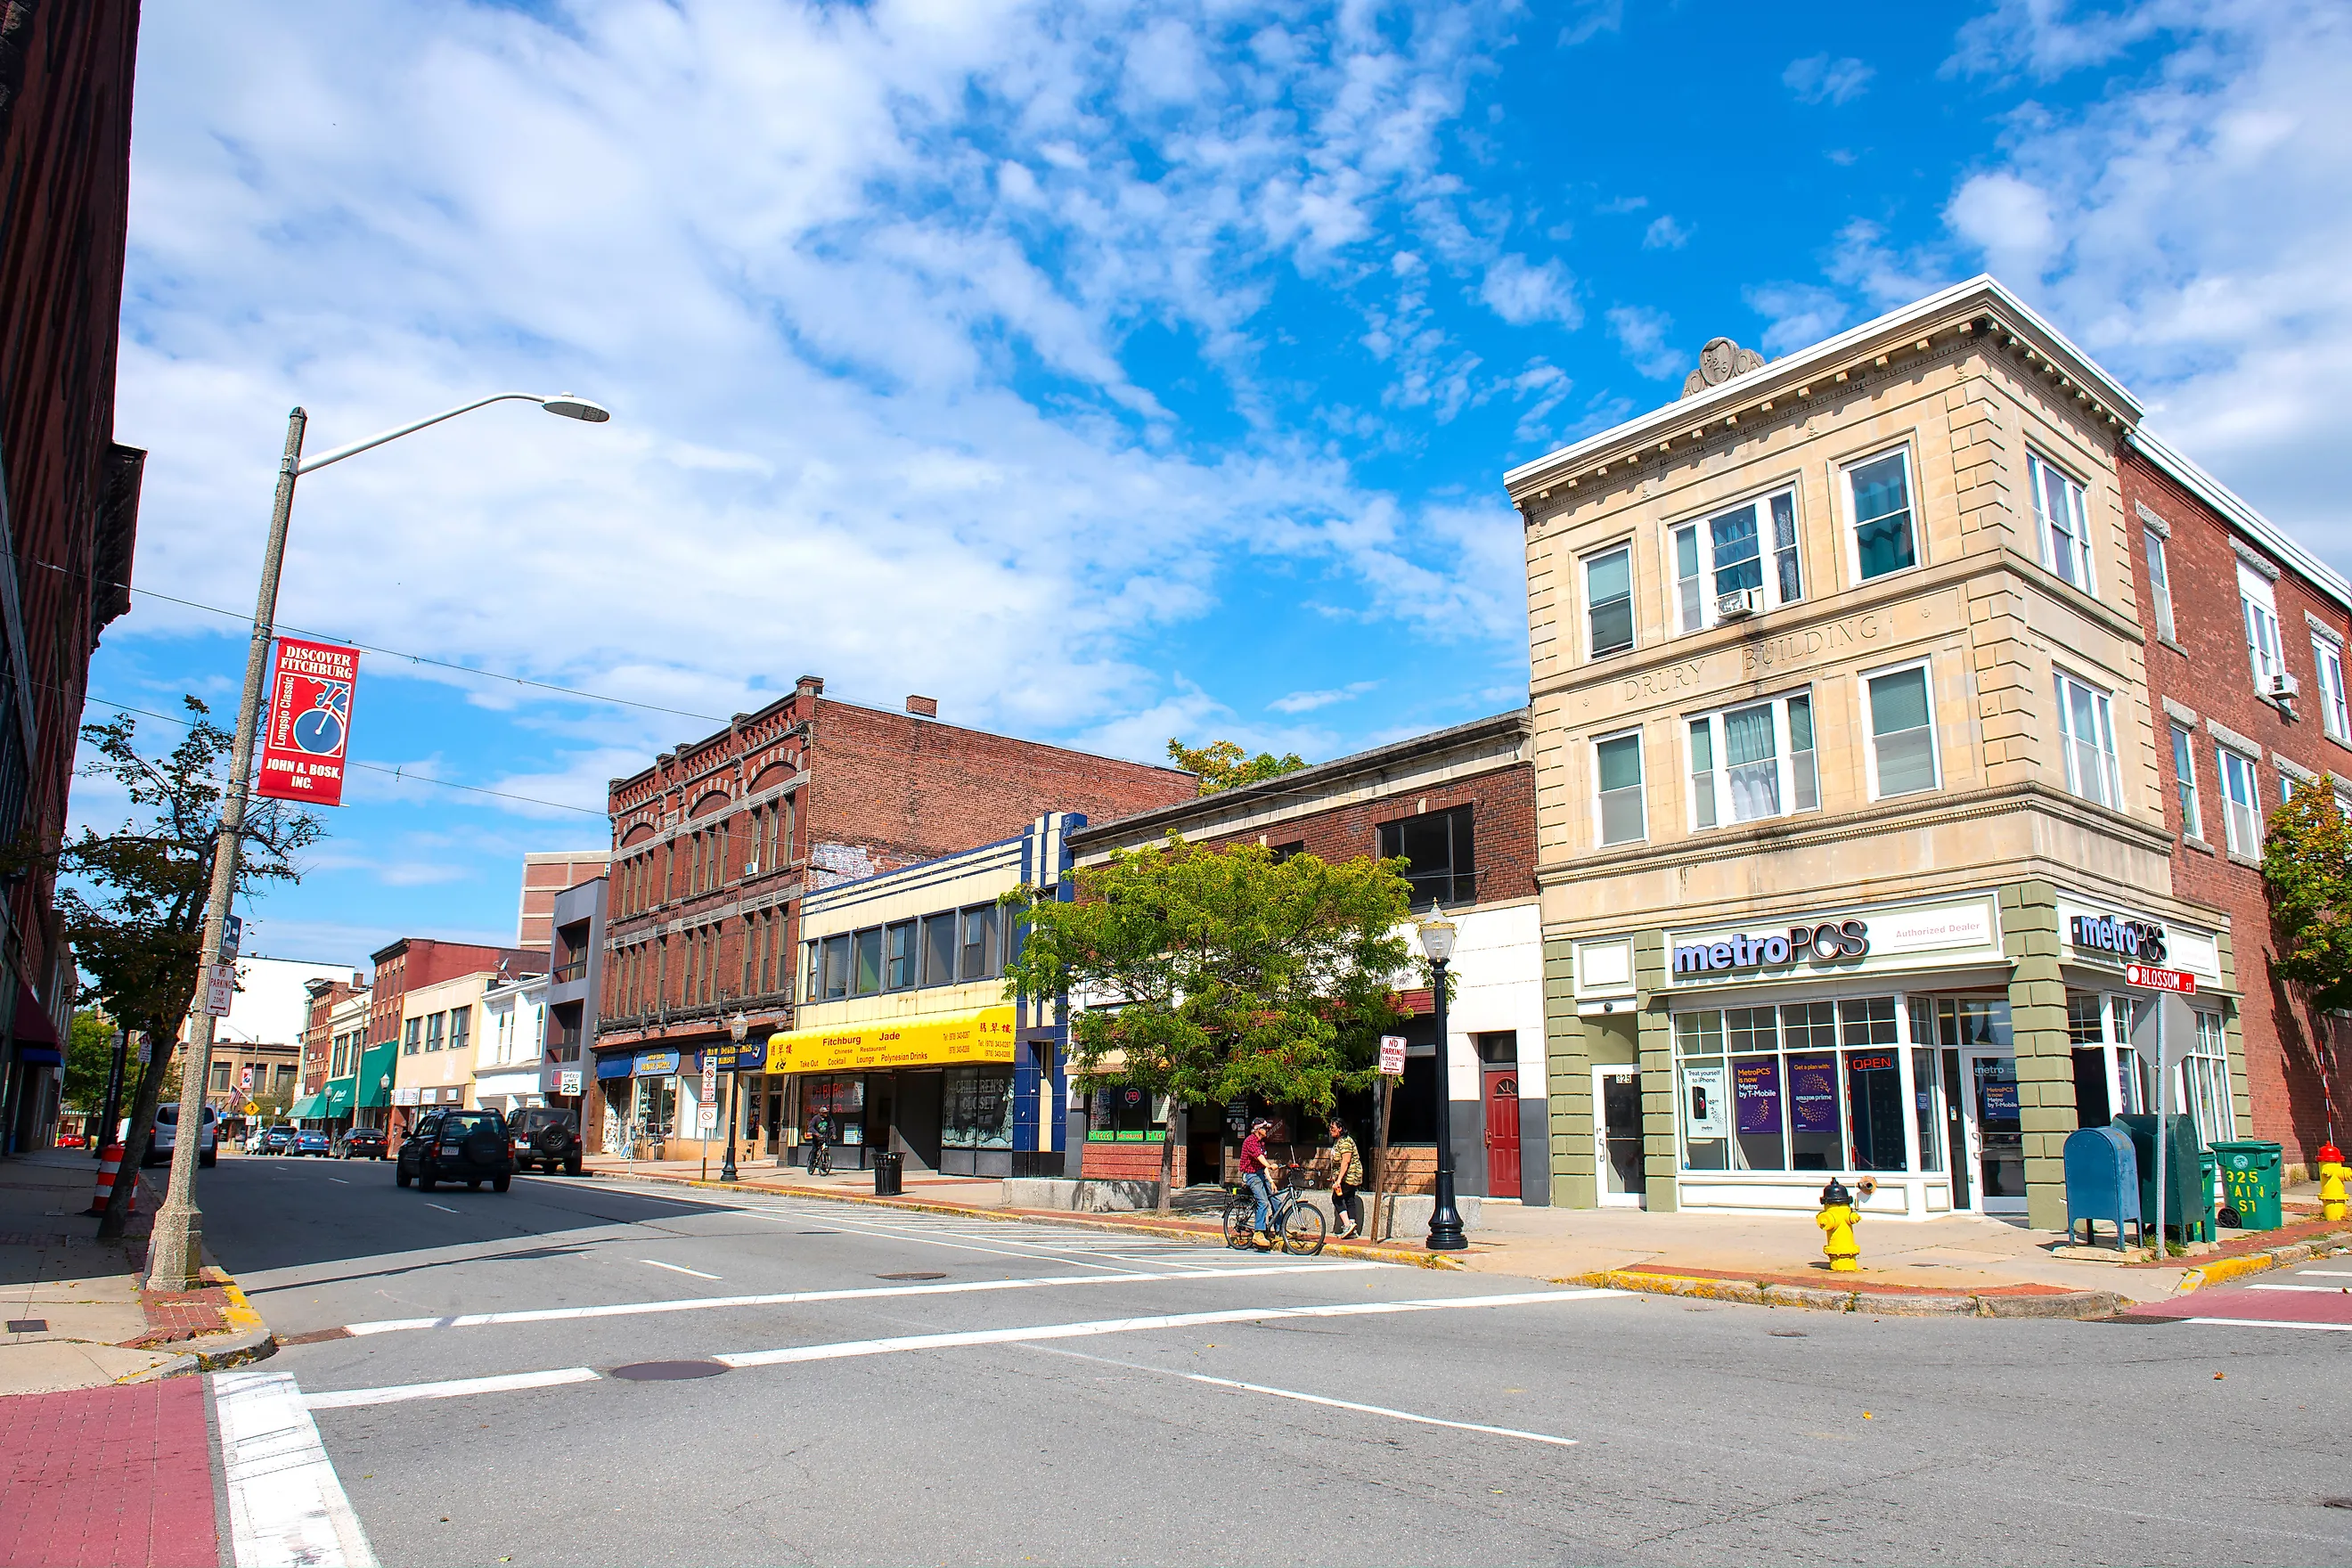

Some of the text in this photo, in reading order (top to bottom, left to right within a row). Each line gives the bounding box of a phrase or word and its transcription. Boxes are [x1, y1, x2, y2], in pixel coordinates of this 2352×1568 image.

[285, 645, 352, 667] DISCOVER
[1623, 616, 1878, 702] DRURY BUILDING
[280, 657, 353, 680] FITCHBURG
[274, 676, 295, 747] Longsjo Classic
[265, 757, 341, 780] JOHN A. BOSK,
[290, 775, 314, 790] INC.
[1673, 919, 1980, 973] metroPCS Authorized Dealer
[2080, 916, 2168, 962] metroPCS
[217, 968, 227, 977] NO
[209, 977, 233, 990] PARKING
[2141, 968, 2192, 992] BLOSSOM ST
[215, 989, 225, 997] TOW
[822, 1031, 901, 1047] Fitchburg Jade
[1388, 1040, 1399, 1048] NO
[860, 1045, 886, 1053] Restaurant
[1382, 1048, 1403, 1057] PARKING
[799, 1052, 928, 1068] Take Out Cocktail Lounge Polynesian Drinks
[1852, 1057, 1891, 1070] OPEN
[1701, 1069, 1720, 1077] yourself
[1737, 1067, 1770, 1076] MetroPCS
[1974, 1066, 2005, 1074] metro
[1616, 1074, 1631, 1083] 325
[562, 1083, 579, 1093] 25
[956, 1078, 1005, 1094] CHILDREN'S
[1125, 1090, 1139, 1101] OPEN
[1738, 1090, 1776, 1099] by T-Mobile
[1815, 1093, 1833, 1101] prime
[962, 1095, 996, 1110] CLOSET
[2225, 1170, 2258, 1184] 325
[2229, 1184, 2265, 1198] AIN
[2238, 1199, 2257, 1213] ST
